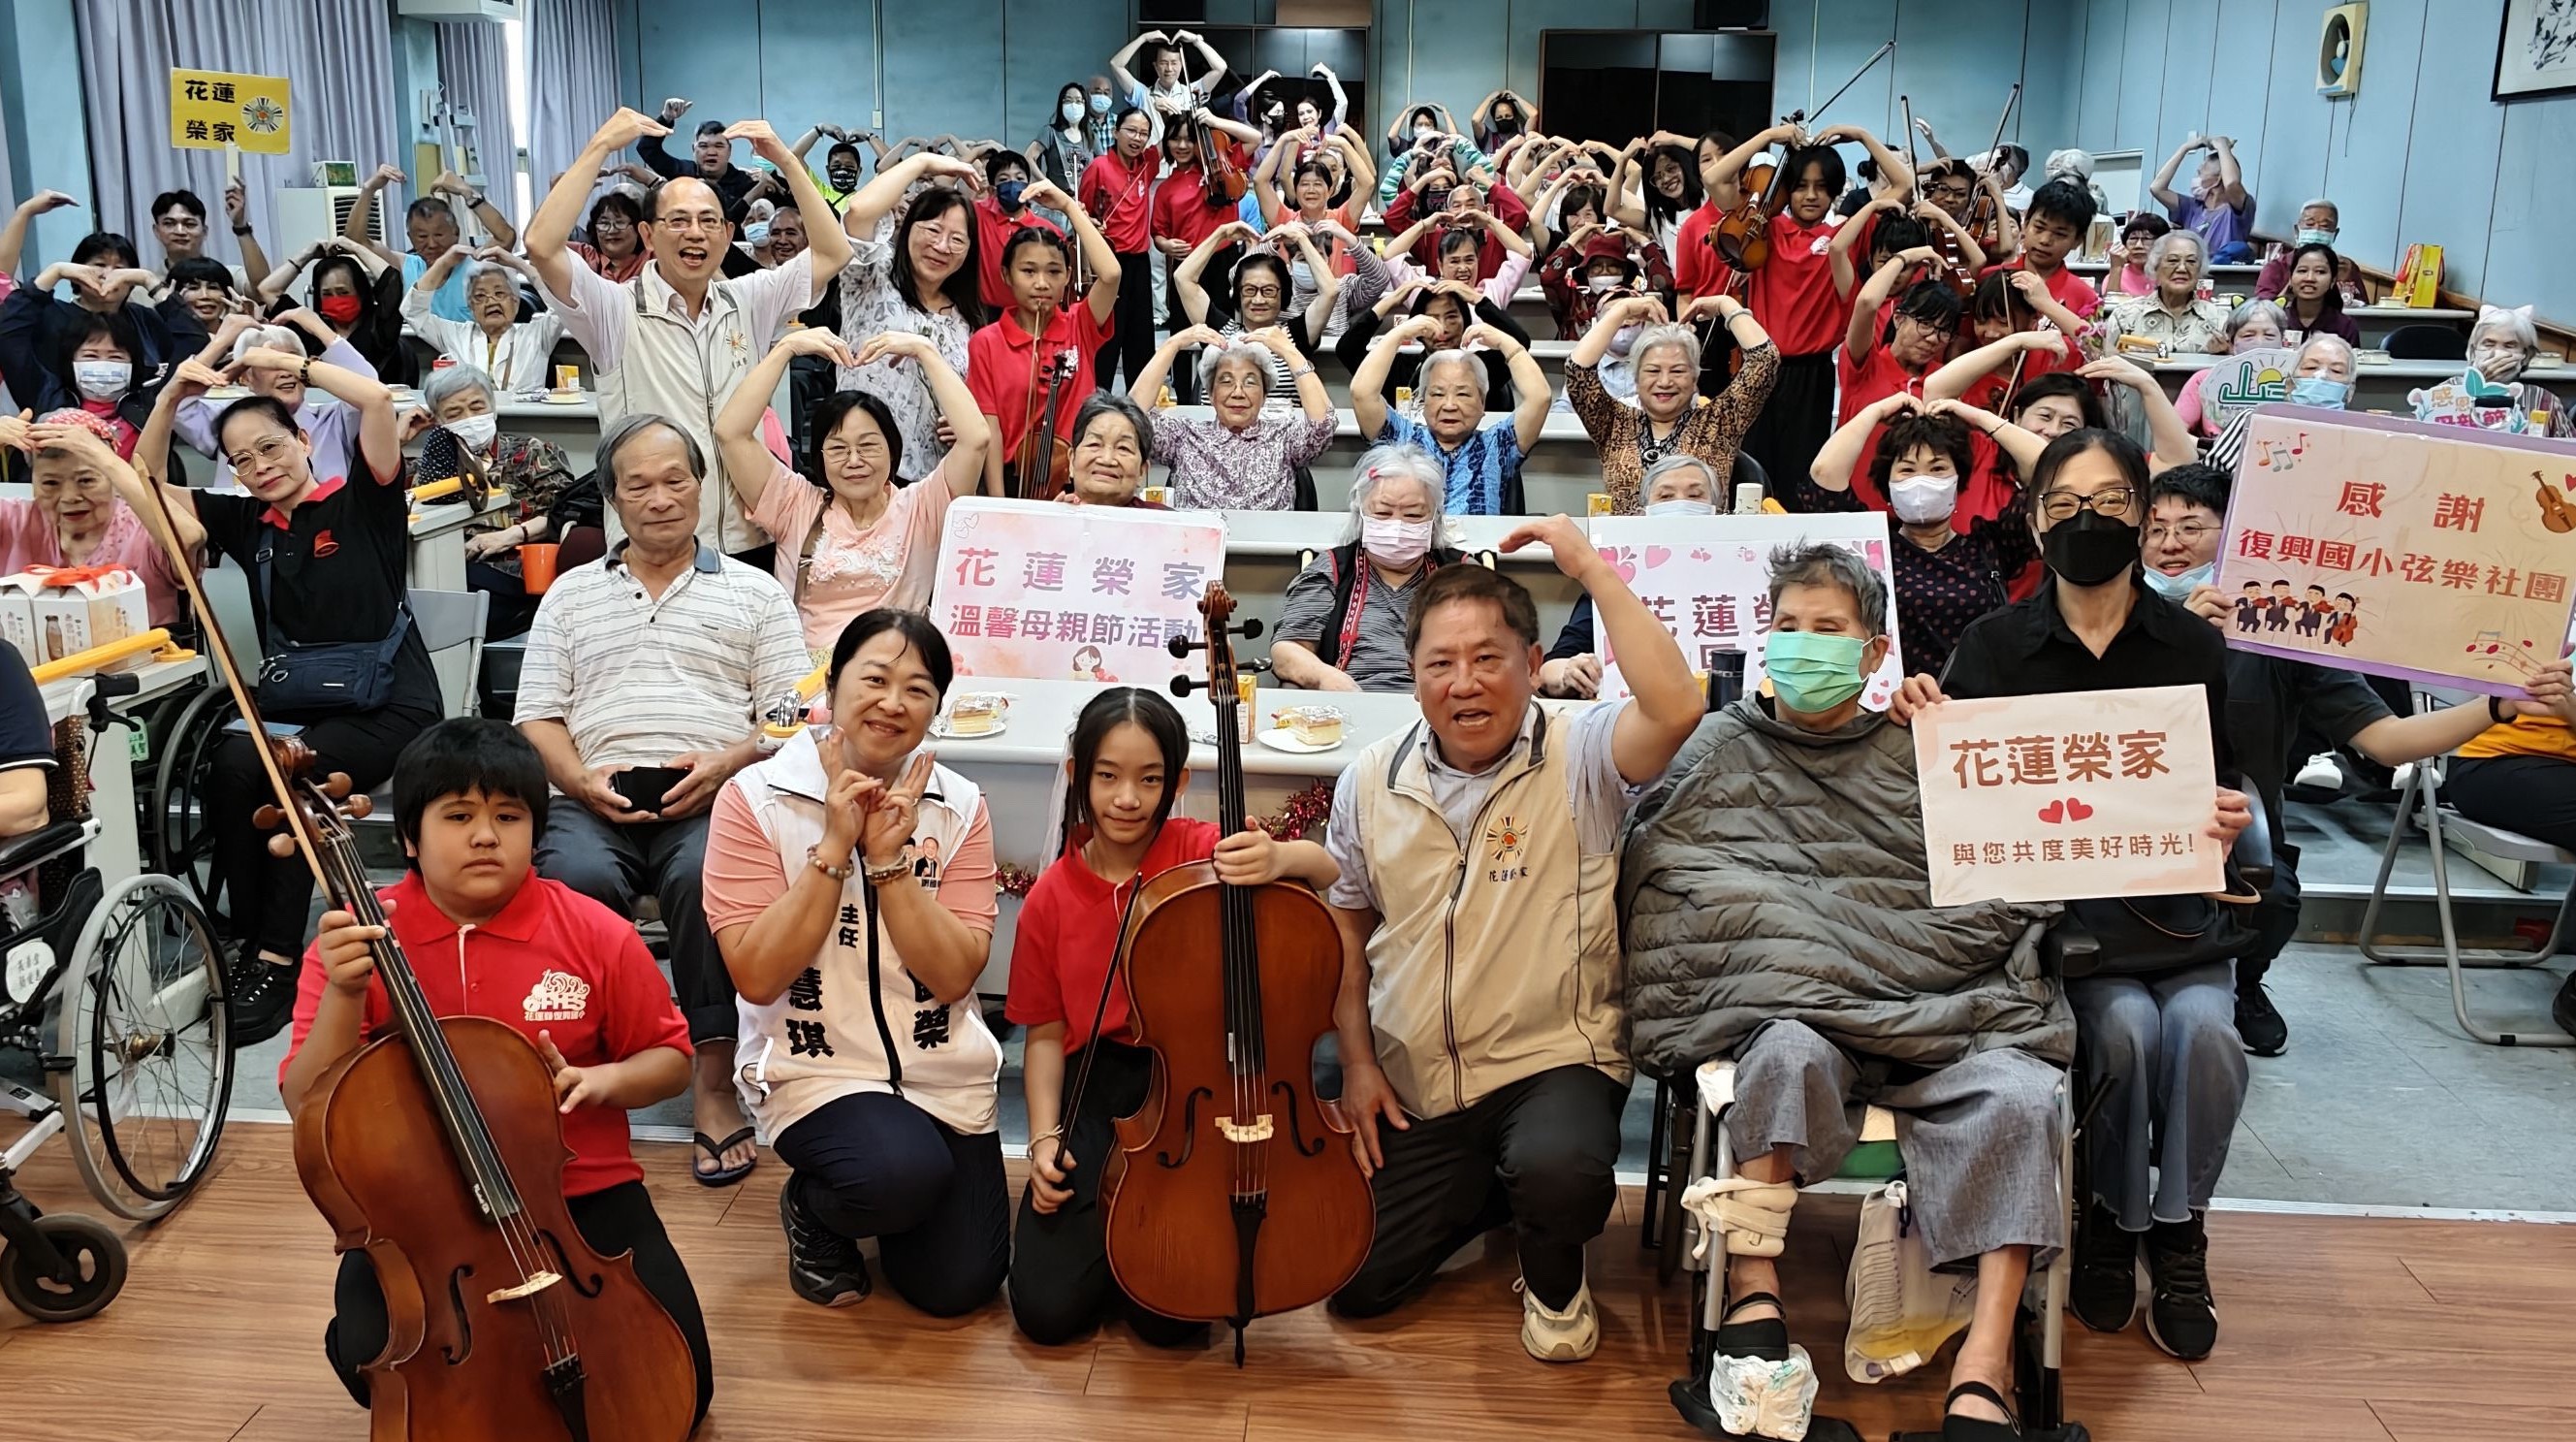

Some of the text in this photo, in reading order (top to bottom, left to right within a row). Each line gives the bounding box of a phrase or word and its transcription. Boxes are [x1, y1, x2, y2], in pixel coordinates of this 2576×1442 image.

[184, 80, 236, 104] 花蓮
[185, 119, 236, 143] 榮家
[2337, 481, 2485, 532] 感謝
[955, 547, 1205, 599] 花蓮榮家
[2240, 529, 2567, 603] 復興國小弦樂社團
[948, 604, 1198, 649] 溫馨母親節活動
[1950, 729, 2171, 789] 花蓮榮家
[839, 904, 859, 948] 主任
[785, 967, 835, 1059] 慧琪
